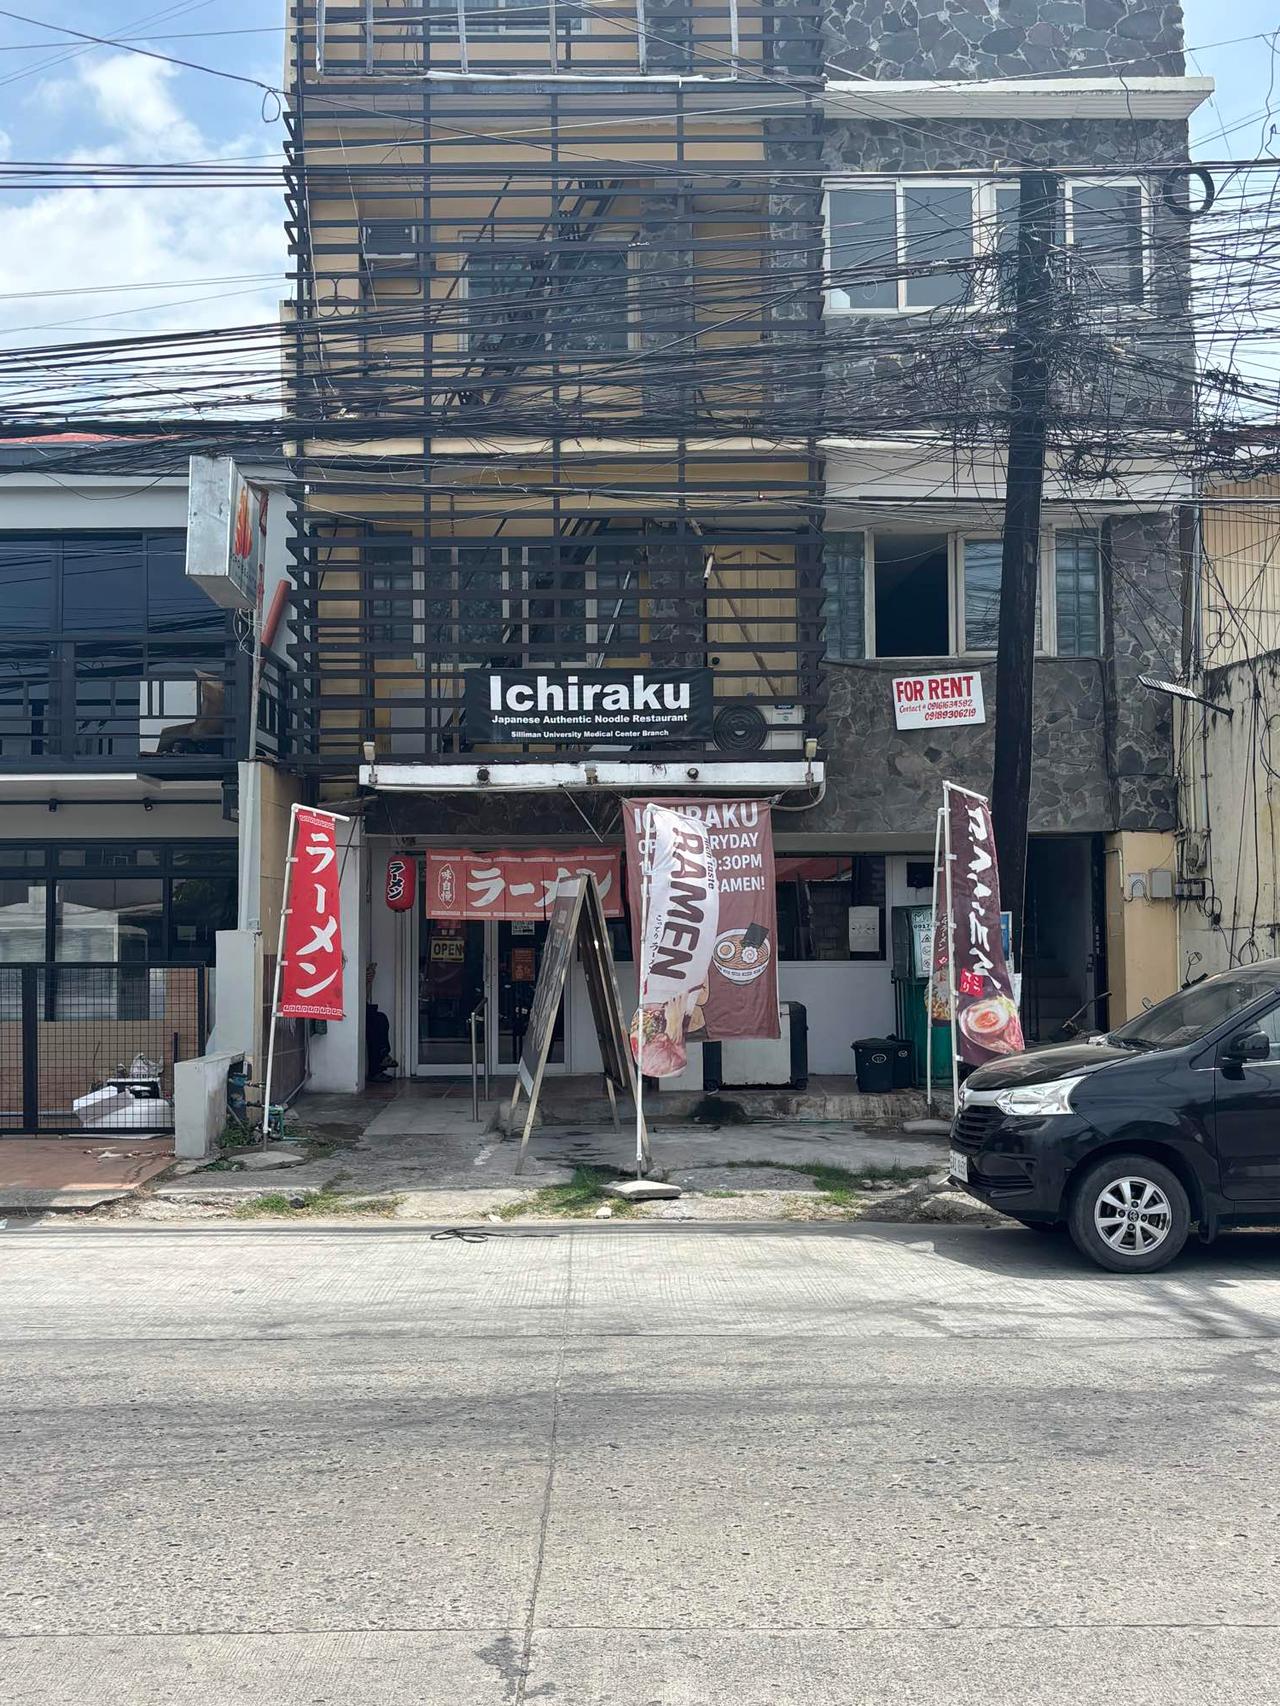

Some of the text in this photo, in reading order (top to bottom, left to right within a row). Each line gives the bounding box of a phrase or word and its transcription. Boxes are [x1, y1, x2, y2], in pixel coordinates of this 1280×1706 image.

[490, 675, 690, 712] Ichiraku
[895, 675, 974, 703] FOR RENT
[491, 713, 688, 725] Japanese Authentic Noodle Restaurant
[543, 731, 582, 739] University
[583, 730, 613, 738] Medical
[642, 729, 669, 737] Branch
[710, 832, 759, 850] RYDAY
[387, 860, 405, 901] ラーメン
[718, 876, 766, 893] AMEN!
[295, 832, 338, 998] ラーメン
[650, 827, 708, 980] RAMEN
[433, 942, 463, 957] OPEN
